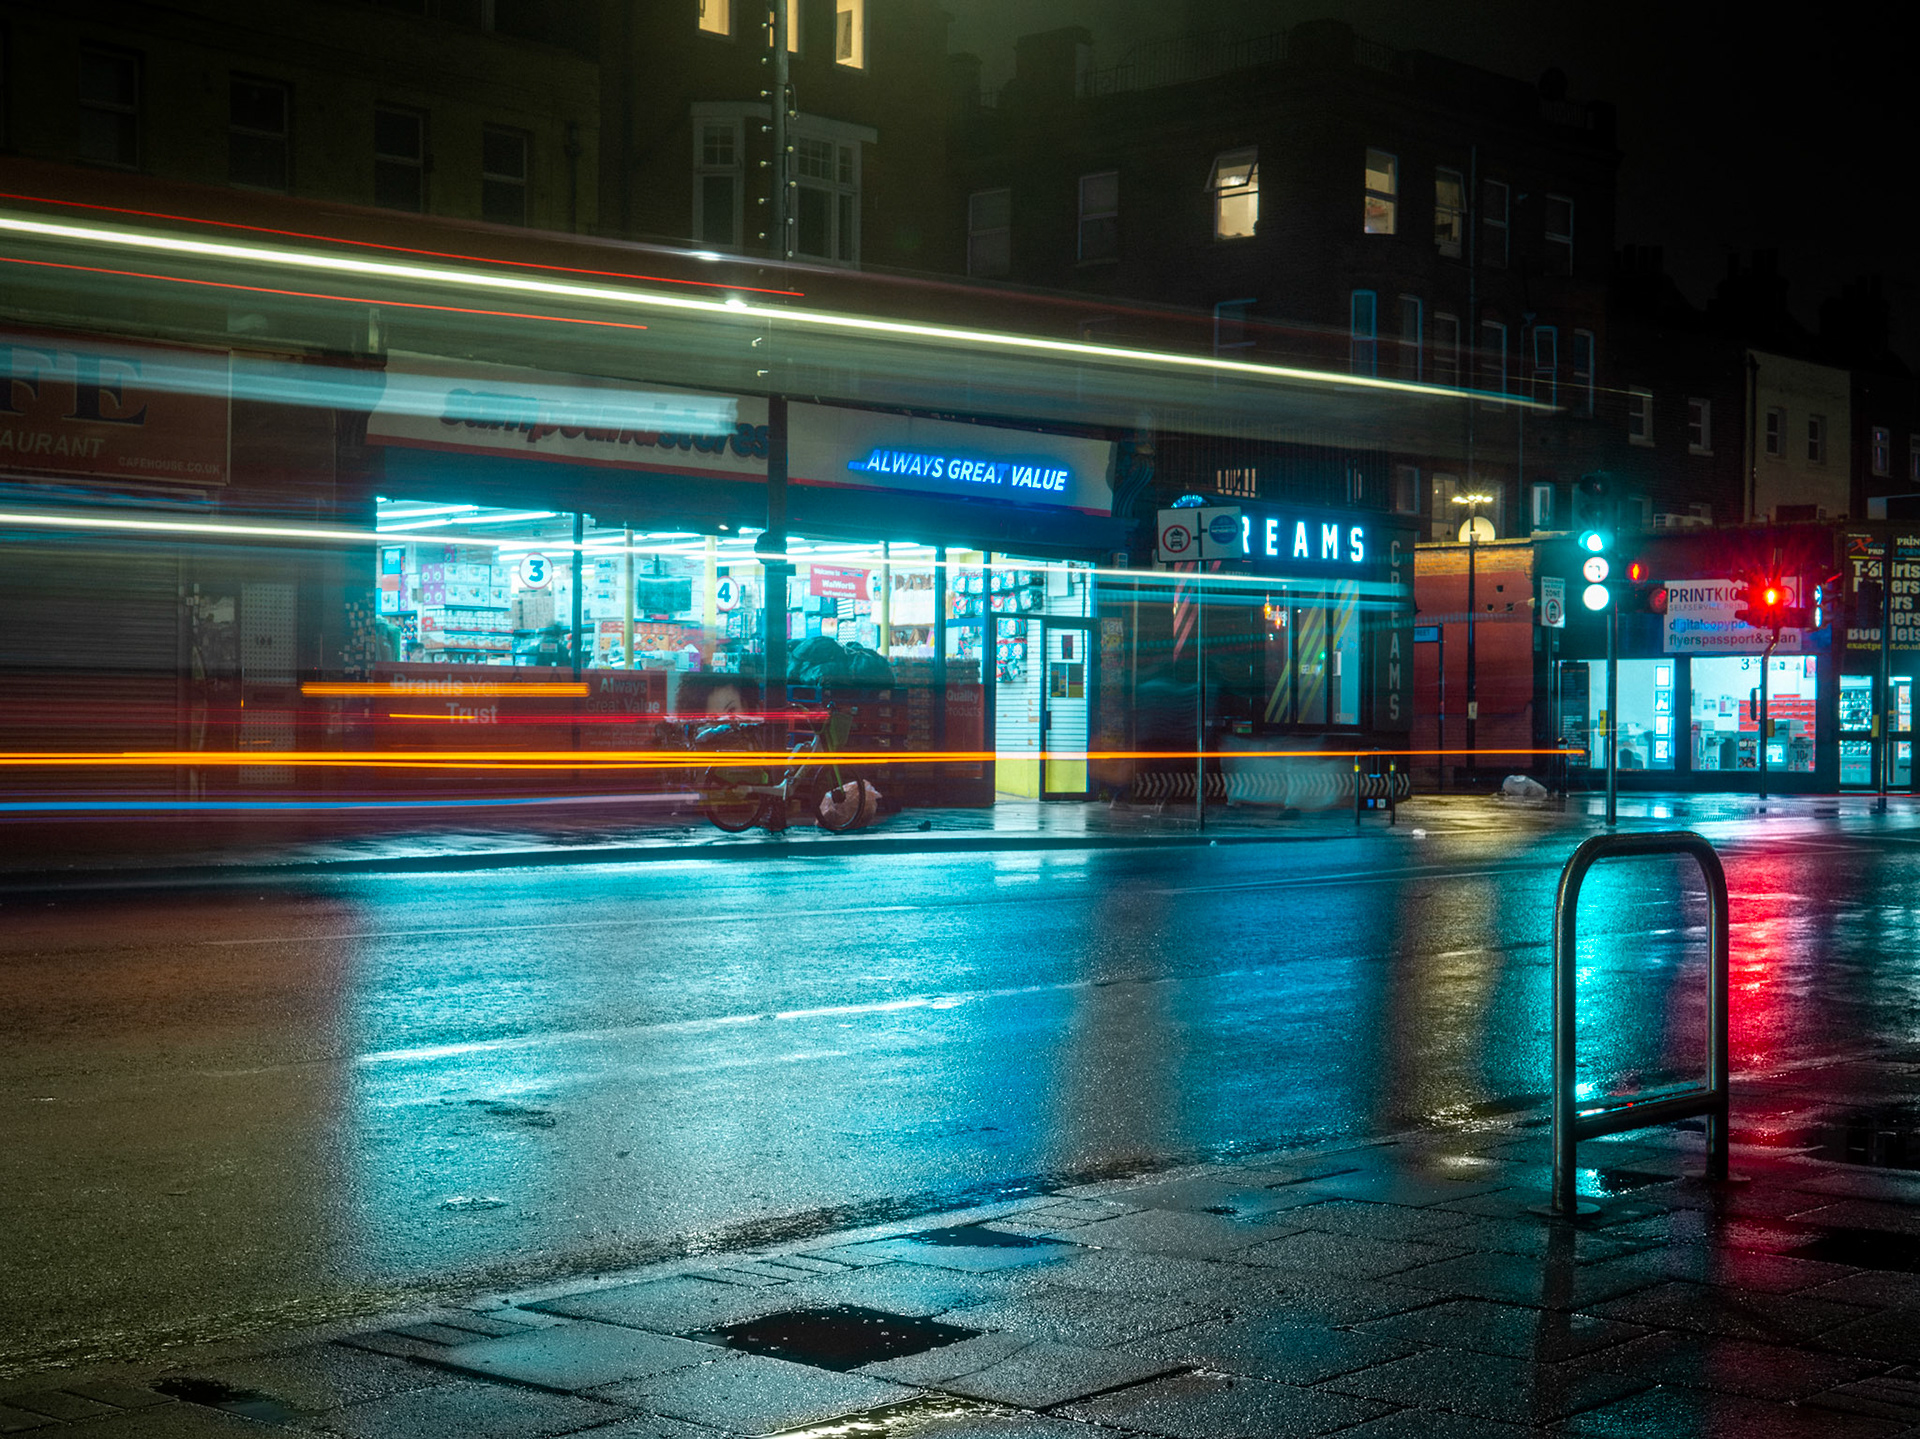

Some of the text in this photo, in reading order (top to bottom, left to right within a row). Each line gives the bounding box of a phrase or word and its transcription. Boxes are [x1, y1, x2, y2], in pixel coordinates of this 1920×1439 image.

[118, 456, 221, 475] CAFEHOUSE.CO.UK
[947, 458, 1010, 484] GREAT
[1011, 465, 1068, 491] VALUE
[1241, 515, 1365, 563] REAMS
[528, 559, 545, 582] 3
[717, 582, 732, 603] 4
[1668, 587, 1741, 603] PRINTKIO
[1669, 632, 1796, 647] flyerspassport&san
[393, 673, 465, 696] Brands
[599, 677, 647, 696] Always
[585, 697, 660, 713] Great Value
[946, 689, 979, 704] Quality
[446, 702, 498, 724] Trust
